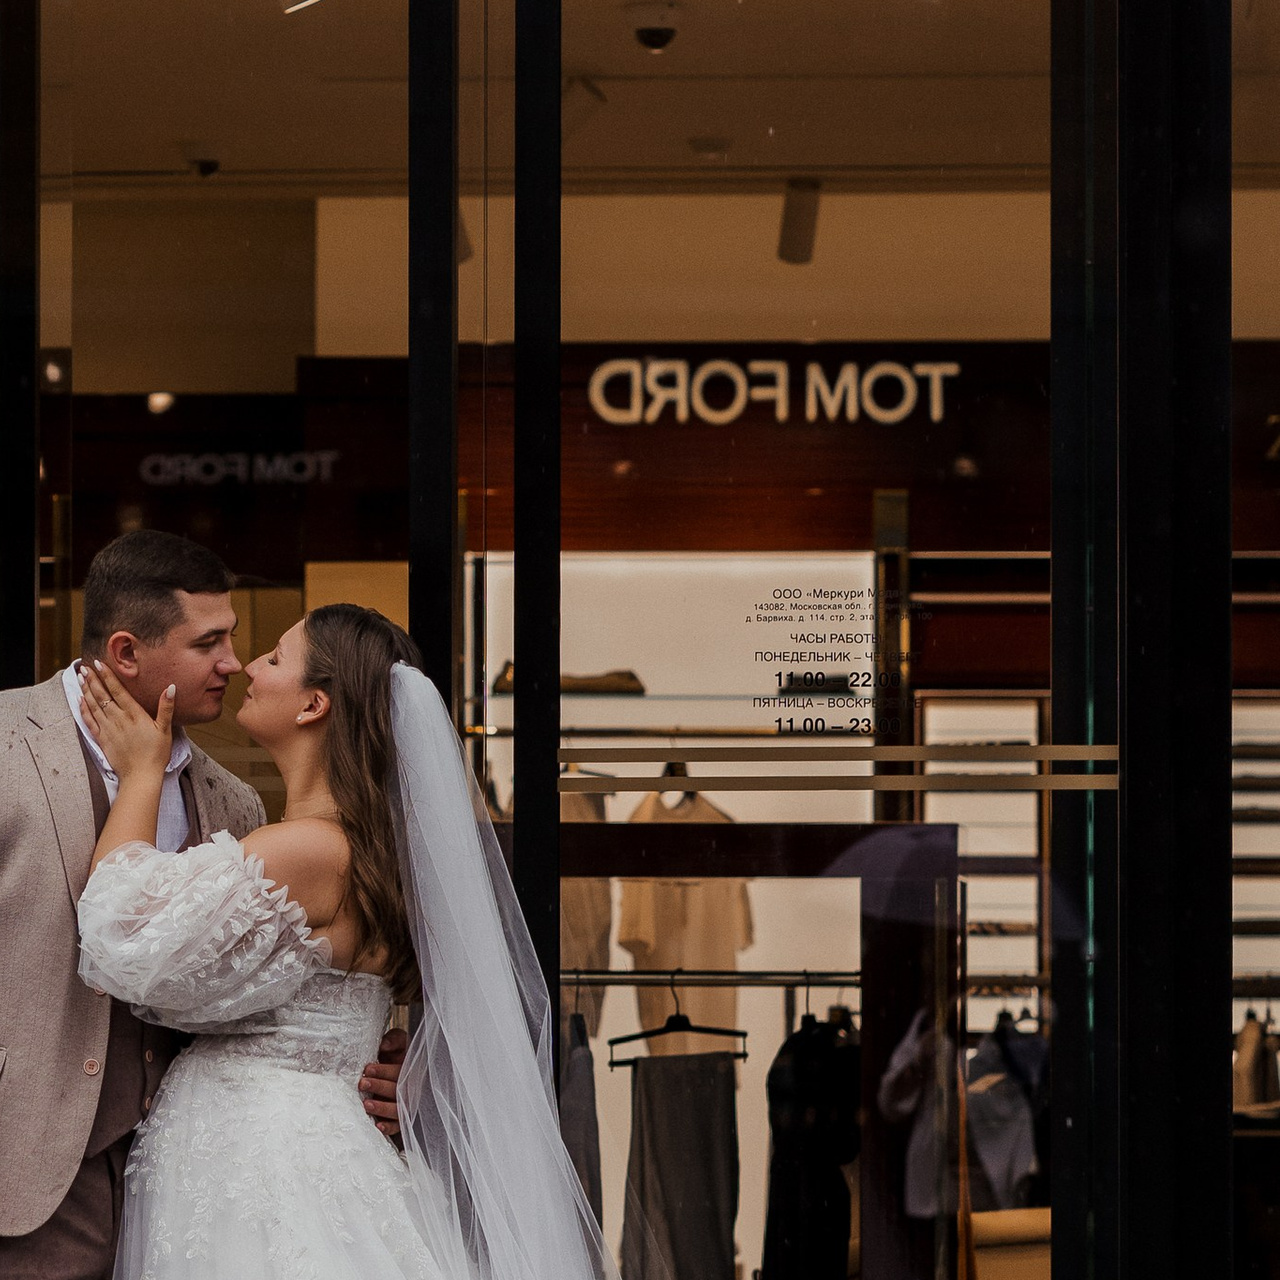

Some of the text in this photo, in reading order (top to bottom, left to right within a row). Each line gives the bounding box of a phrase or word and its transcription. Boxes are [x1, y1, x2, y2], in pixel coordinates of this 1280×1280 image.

[772, 588, 903, 601] ООО «Меркури Мода
[790, 603, 842, 611] Московская
[790, 633, 826, 643] ЧАСЫ
[754, 651, 851, 663] ПОНЕДЕЛЬНИК
[775, 671, 825, 687] 11.00
[849, 672, 900, 687] 22.00
[753, 697, 813, 709] ПЯТНИЦА
[775, 717, 825, 733] 11.00
[849, 718, 900, 733] 23.00
